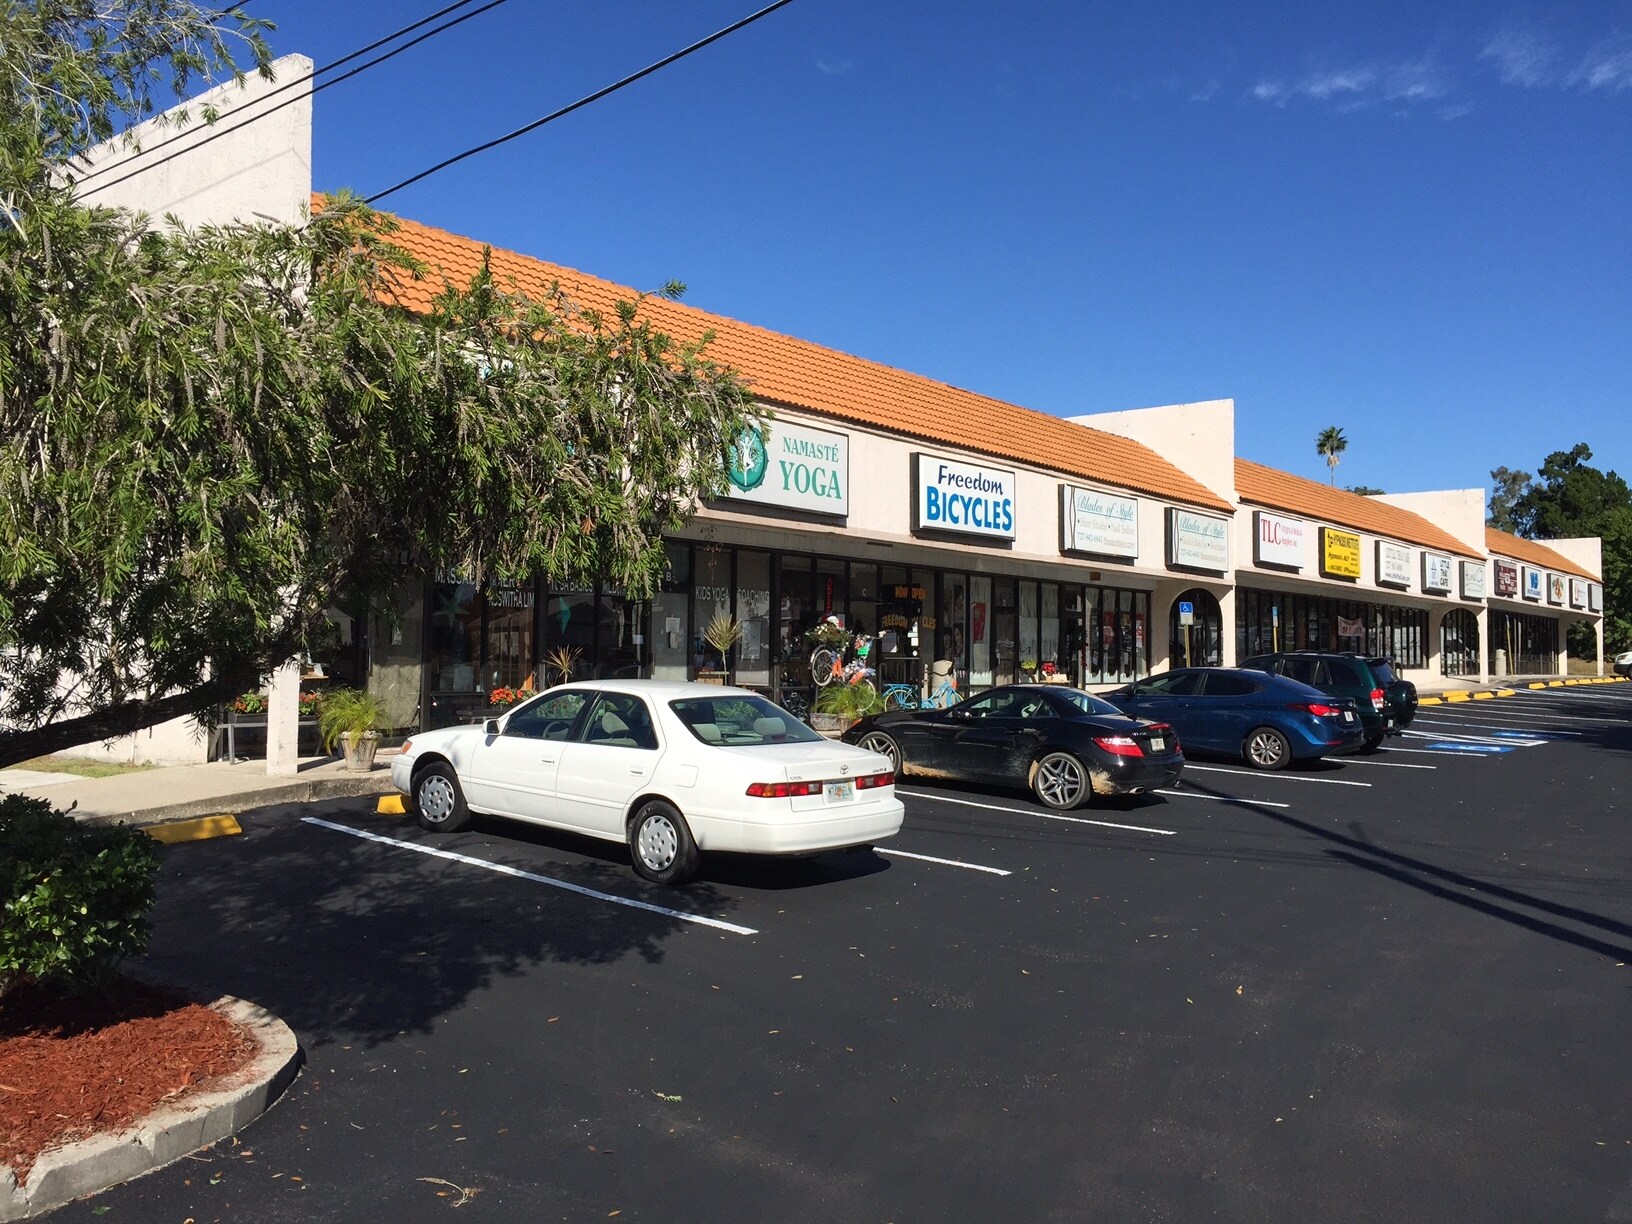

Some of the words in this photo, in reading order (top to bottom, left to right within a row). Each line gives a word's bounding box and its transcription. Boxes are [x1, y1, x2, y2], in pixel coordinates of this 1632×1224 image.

[783, 437, 839, 462] NAMASTÉ
[779, 460, 842, 499] YOGA
[938, 465, 1003, 495] Freedom
[927, 485, 1012, 531] BICYCLES
[1077, 495, 1103, 513] Blades
[1106, 502, 1116, 519] of
[1117, 503, 1133, 522] Style
[1261, 518, 1281, 545] TLC
[695, 585, 710, 600] KIDS
[711, 586, 729, 601] YOGA
[737, 587, 769, 603] COACHING
[912, 587, 928, 600] OPEN
[882, 614, 908, 629] FREEDOM
